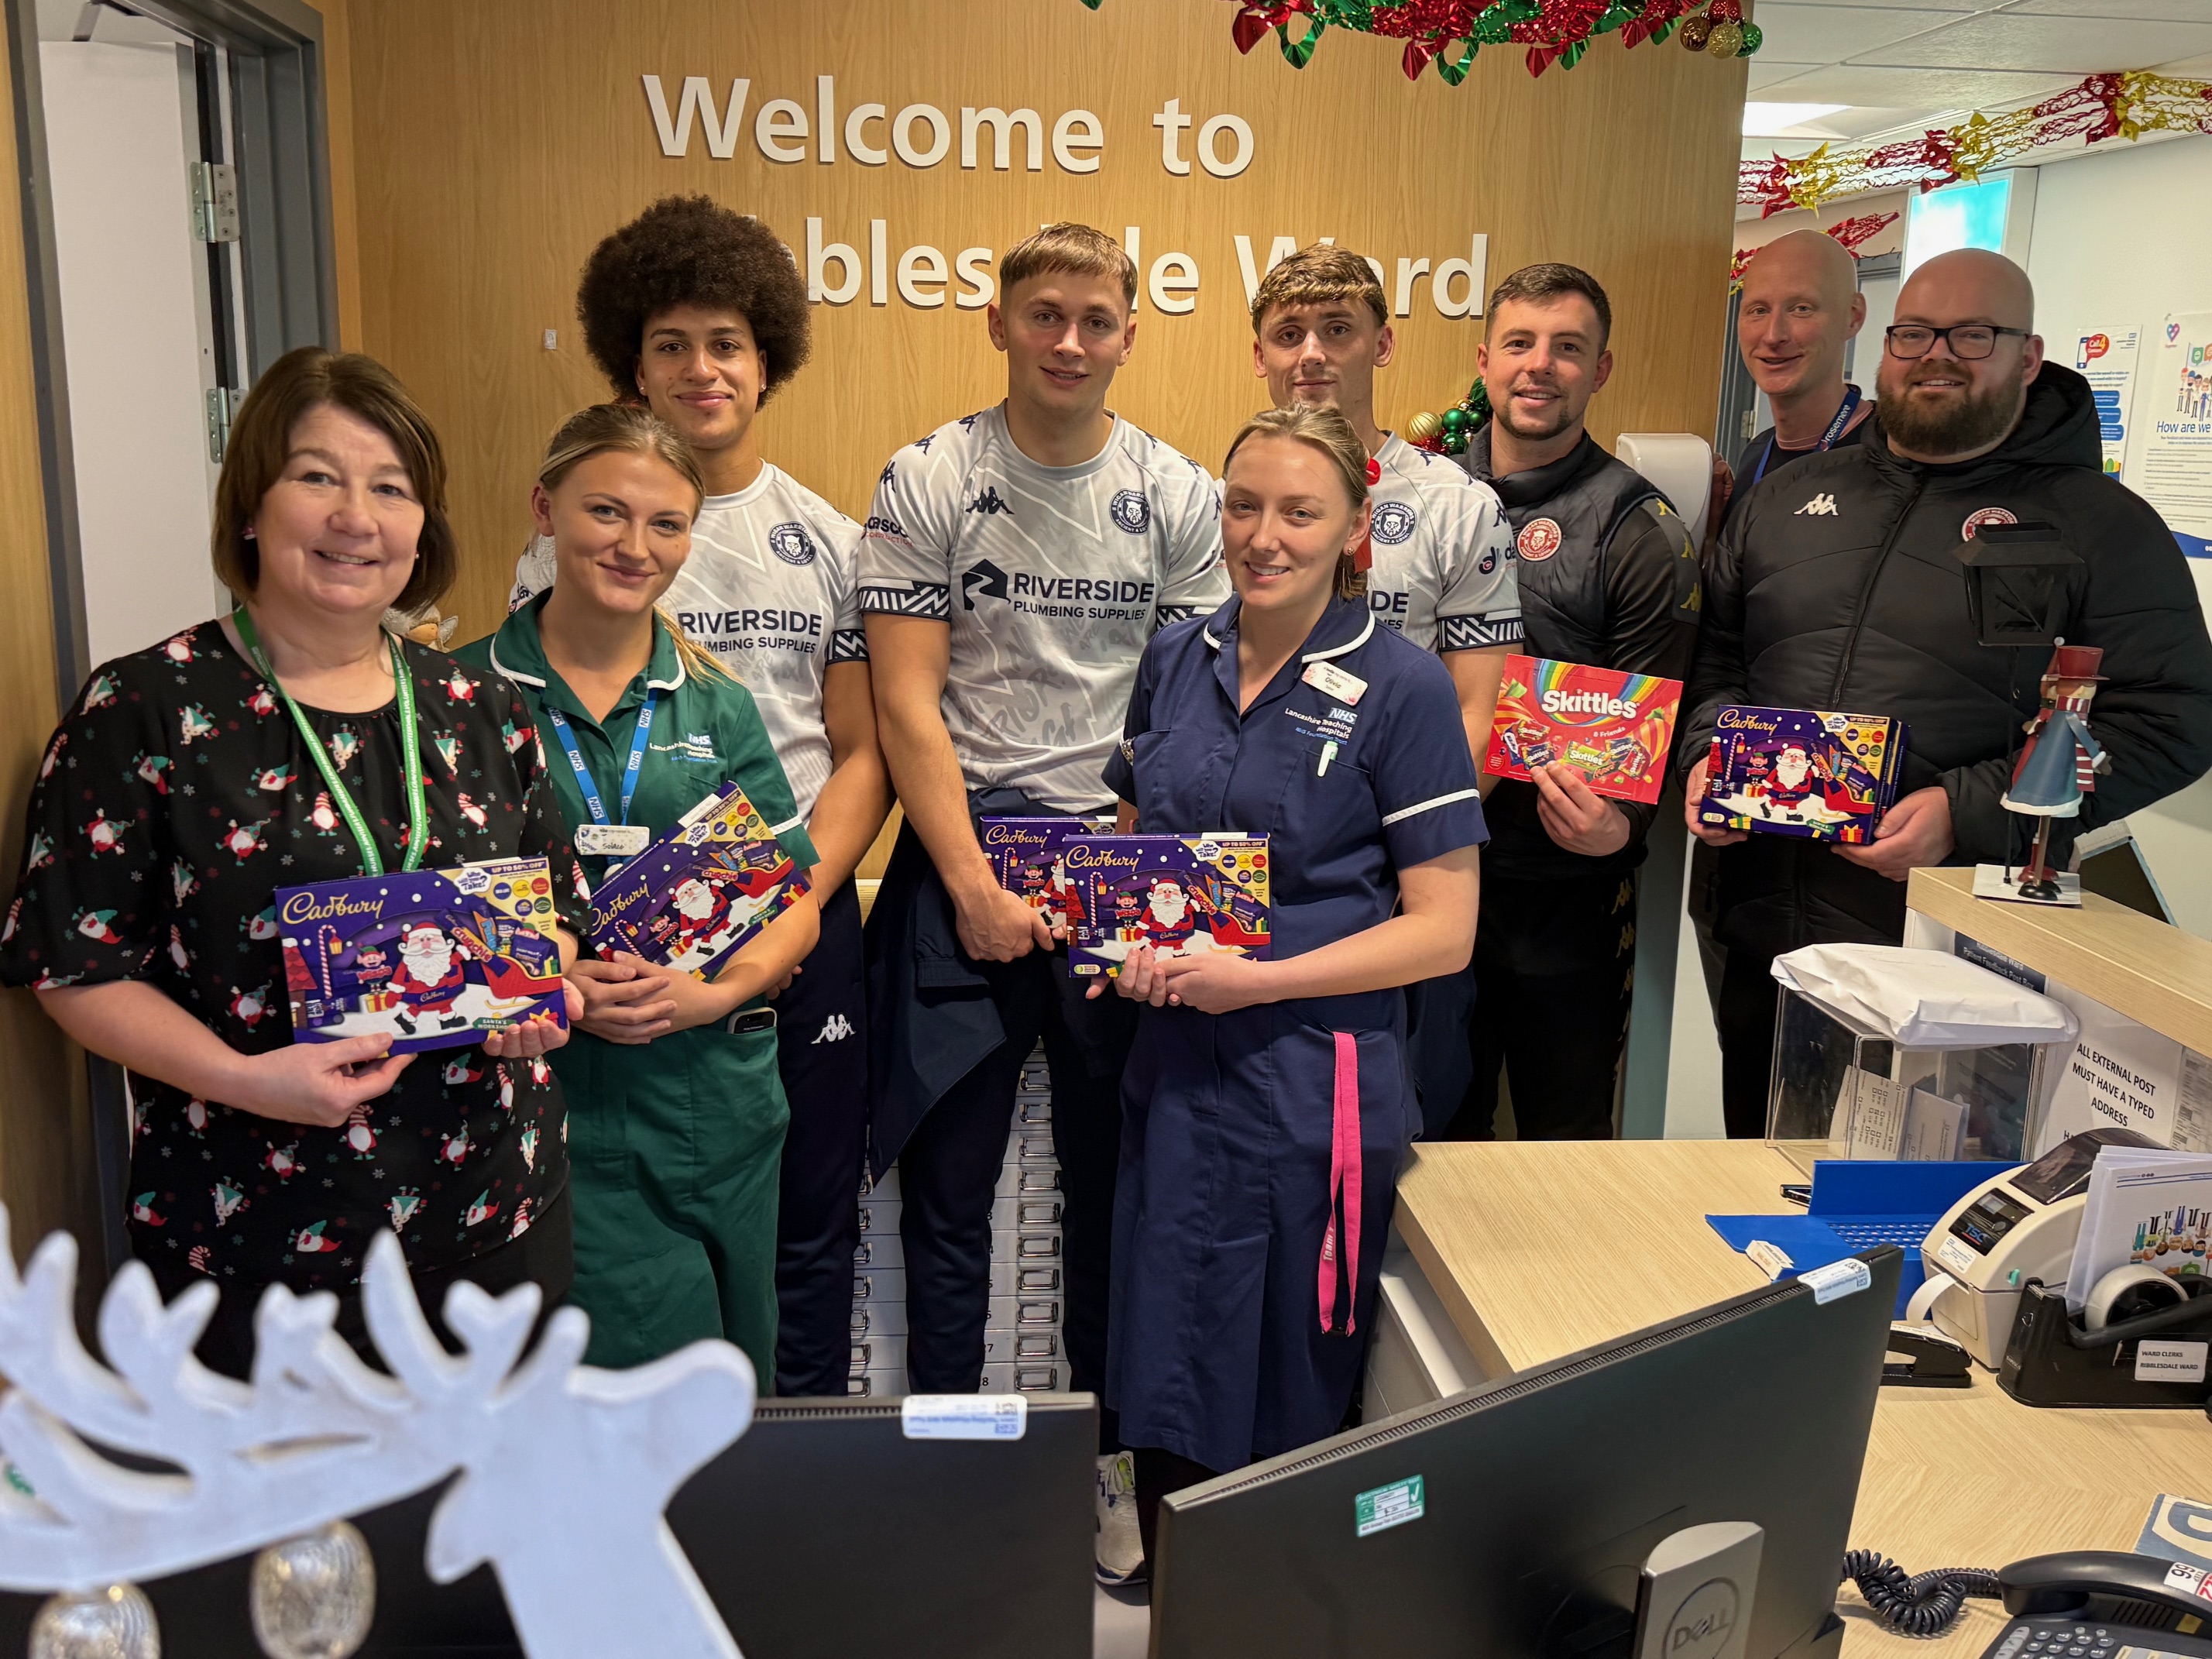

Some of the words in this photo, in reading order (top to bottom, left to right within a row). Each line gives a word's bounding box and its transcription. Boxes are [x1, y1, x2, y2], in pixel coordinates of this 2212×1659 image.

[642, 74, 1104, 173] Welcome
[1152, 97, 1255, 178] to
[1234, 234, 1488, 316] Wrd
[2156, 421, 2179, 433] How
[2181, 424, 2196, 433] are
[2199, 424, 2211, 433] we
[1014, 573, 1155, 603] RIVERSIDE
[1014, 601, 1084, 618] PLUMBING
[1088, 607, 1146, 620] SUPPLIES
[678, 610, 823, 637] RIVERSIDE
[758, 637, 816, 654] SUPPLIES
[548, 706, 565, 726] NHS
[1329, 708, 1357, 723] NHS
[1542, 689, 1637, 719] Skittles
[641, 709, 651, 726] NHS
[1285, 708, 1321, 726] Lancashire
[1322, 719, 1352, 733] Teaching
[1717, 709, 1778, 736] Cadbury
[1317, 726, 1349, 739] Hospitals
[1600, 726, 1626, 737] Friends
[569, 751, 584, 769] NHS
[630, 752, 641, 769] NHS
[1569, 750, 1603, 766] Skittles
[589, 799, 604, 818] NHS
[986, 825, 1047, 848] Cadbury
[1066, 845, 1139, 871] Cadbury
[702, 870, 737, 881] crunchie
[283, 891, 384, 925] Cadbury
[1188, 885, 1216, 915] crunchie
[453, 928, 492, 962] crunchie
[2077, 1043, 2090, 1059] ALL
[2092, 1051, 2131, 1084] EXTERNAL
[2134, 1075, 2155, 1096] POST
[2073, 1062, 2096, 1084] MUST
[2097, 1077, 2118, 1098] HAVE
[2120, 1091, 2126, 1104] A
[2128, 1095, 2155, 1119] TYPED
[2091, 1097, 2128, 1126] ADDRESS
[1965, 1223, 1990, 1243] TSC
[1672, 1609, 1730, 1651] DELL
